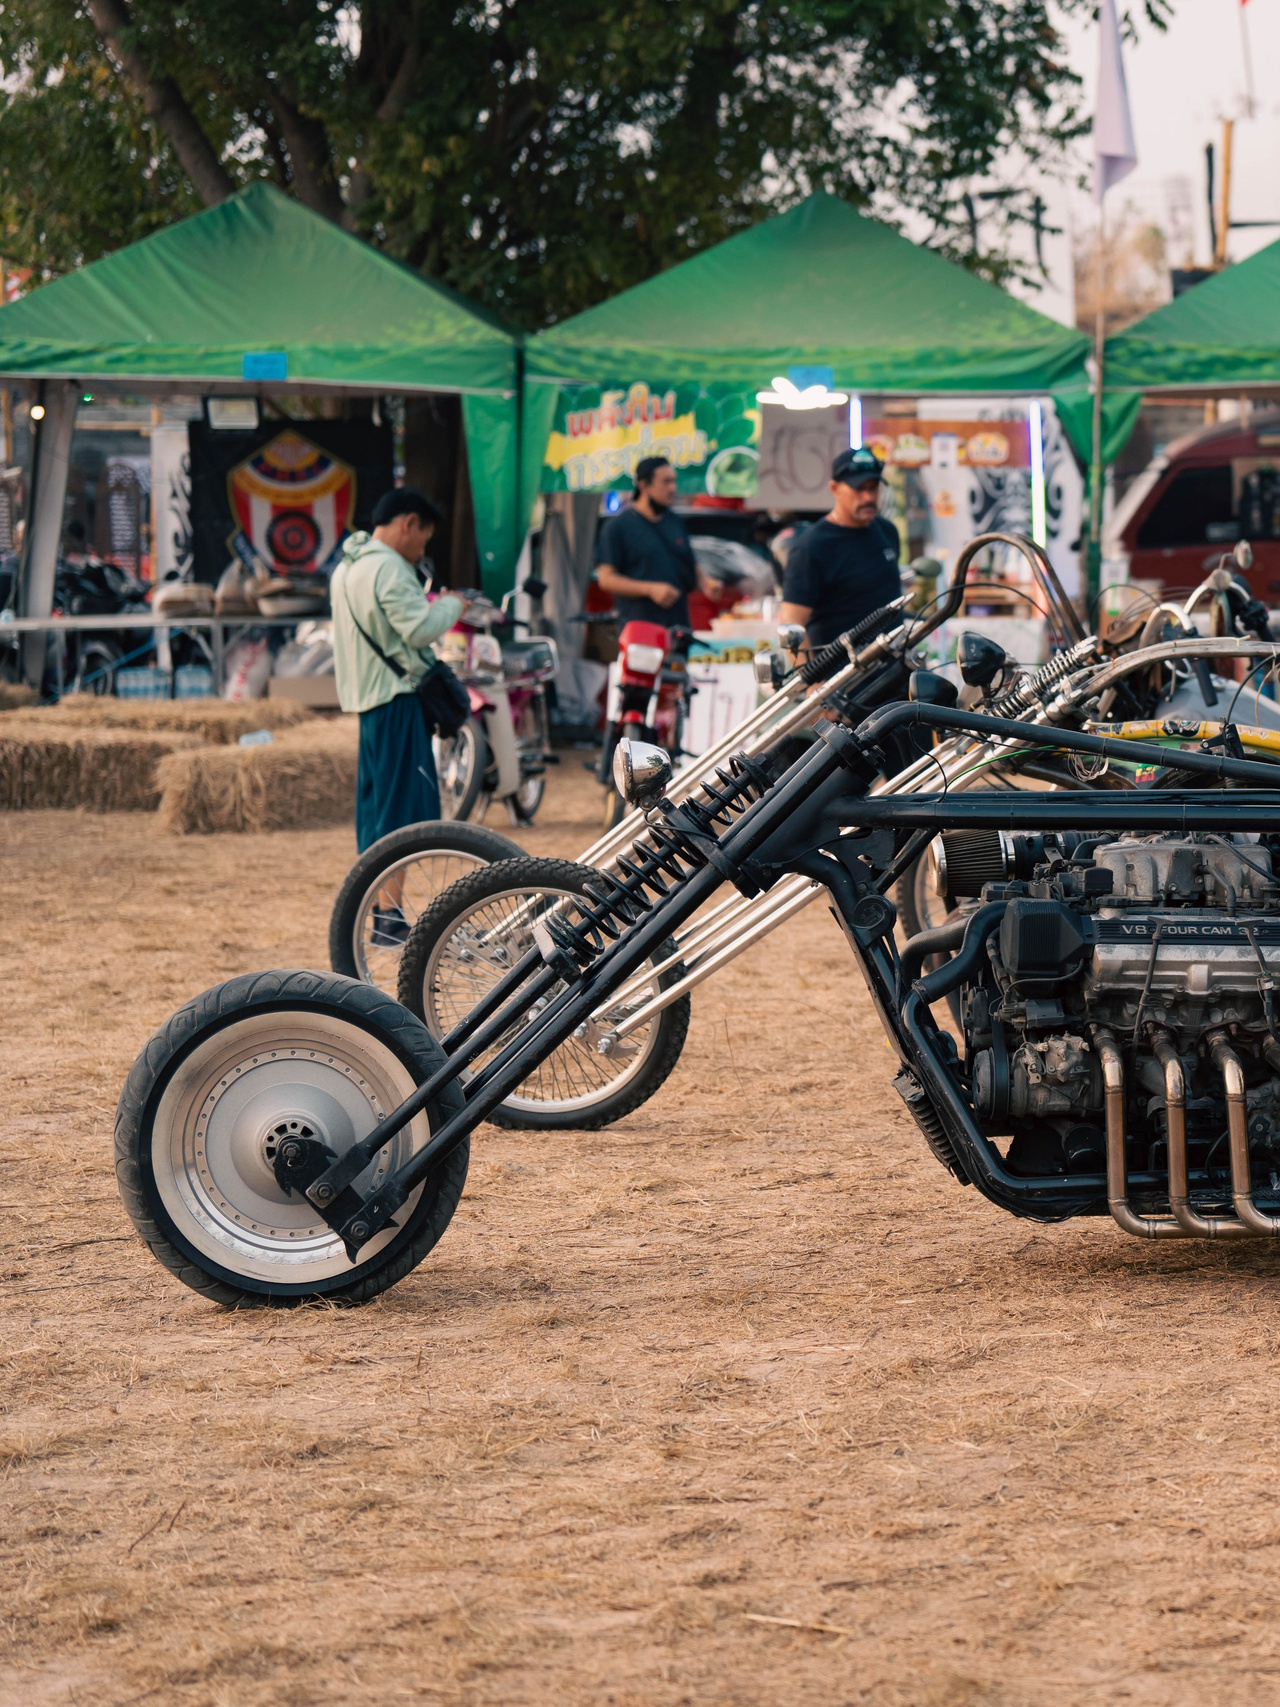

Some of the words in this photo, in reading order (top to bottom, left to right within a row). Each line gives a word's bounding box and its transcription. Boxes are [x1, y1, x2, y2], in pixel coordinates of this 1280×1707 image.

[1121, 924, 1148, 935] V8
[1160, 926, 1199, 935] FOUR
[1201, 926, 1232, 935] CAM
[1238, 926, 1260, 936] 32
